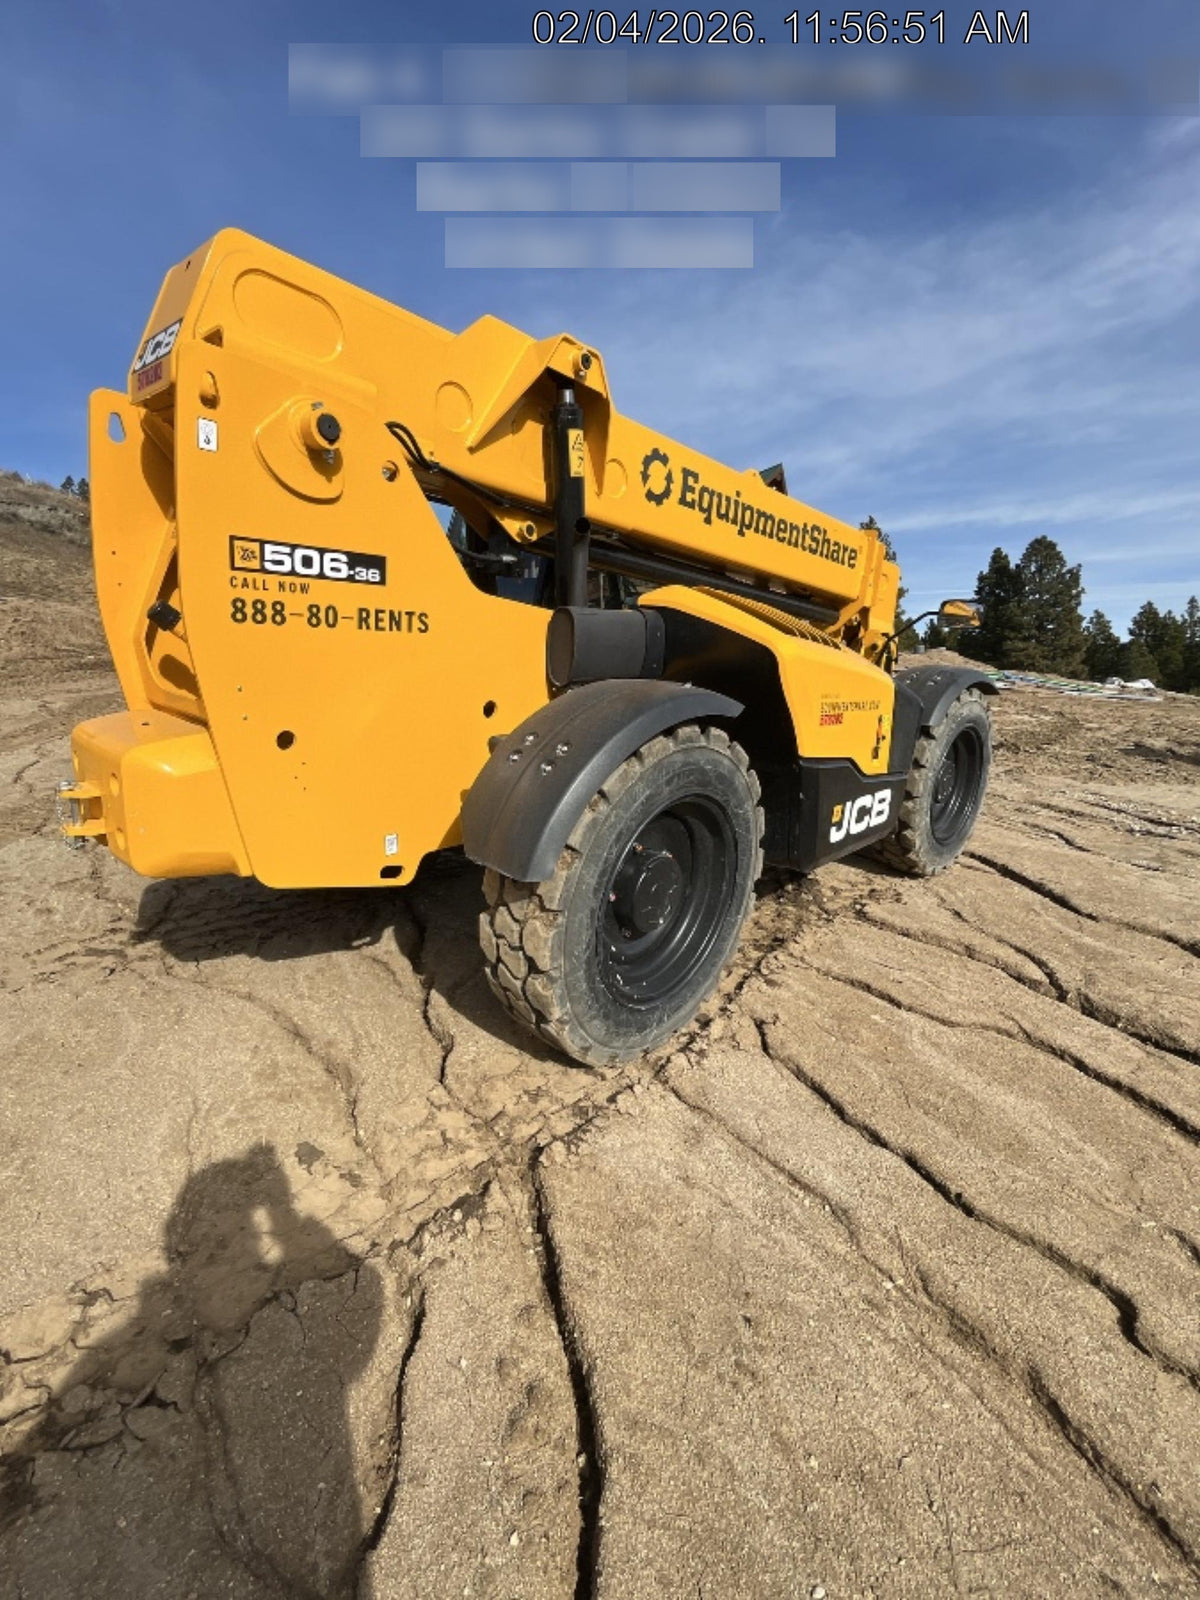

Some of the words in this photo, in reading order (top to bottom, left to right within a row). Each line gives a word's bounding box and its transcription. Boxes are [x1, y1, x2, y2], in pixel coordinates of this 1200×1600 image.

[134, 321, 181, 371] JCB
[678, 467, 859, 569] EquipmentShare
[263, 543, 381, 582] 506-36
[230, 576, 269, 591] CALL
[278, 581, 310, 595] NOW
[230, 597, 429, 633] 888-80-RENTS
[829, 788, 892, 843] JCB
